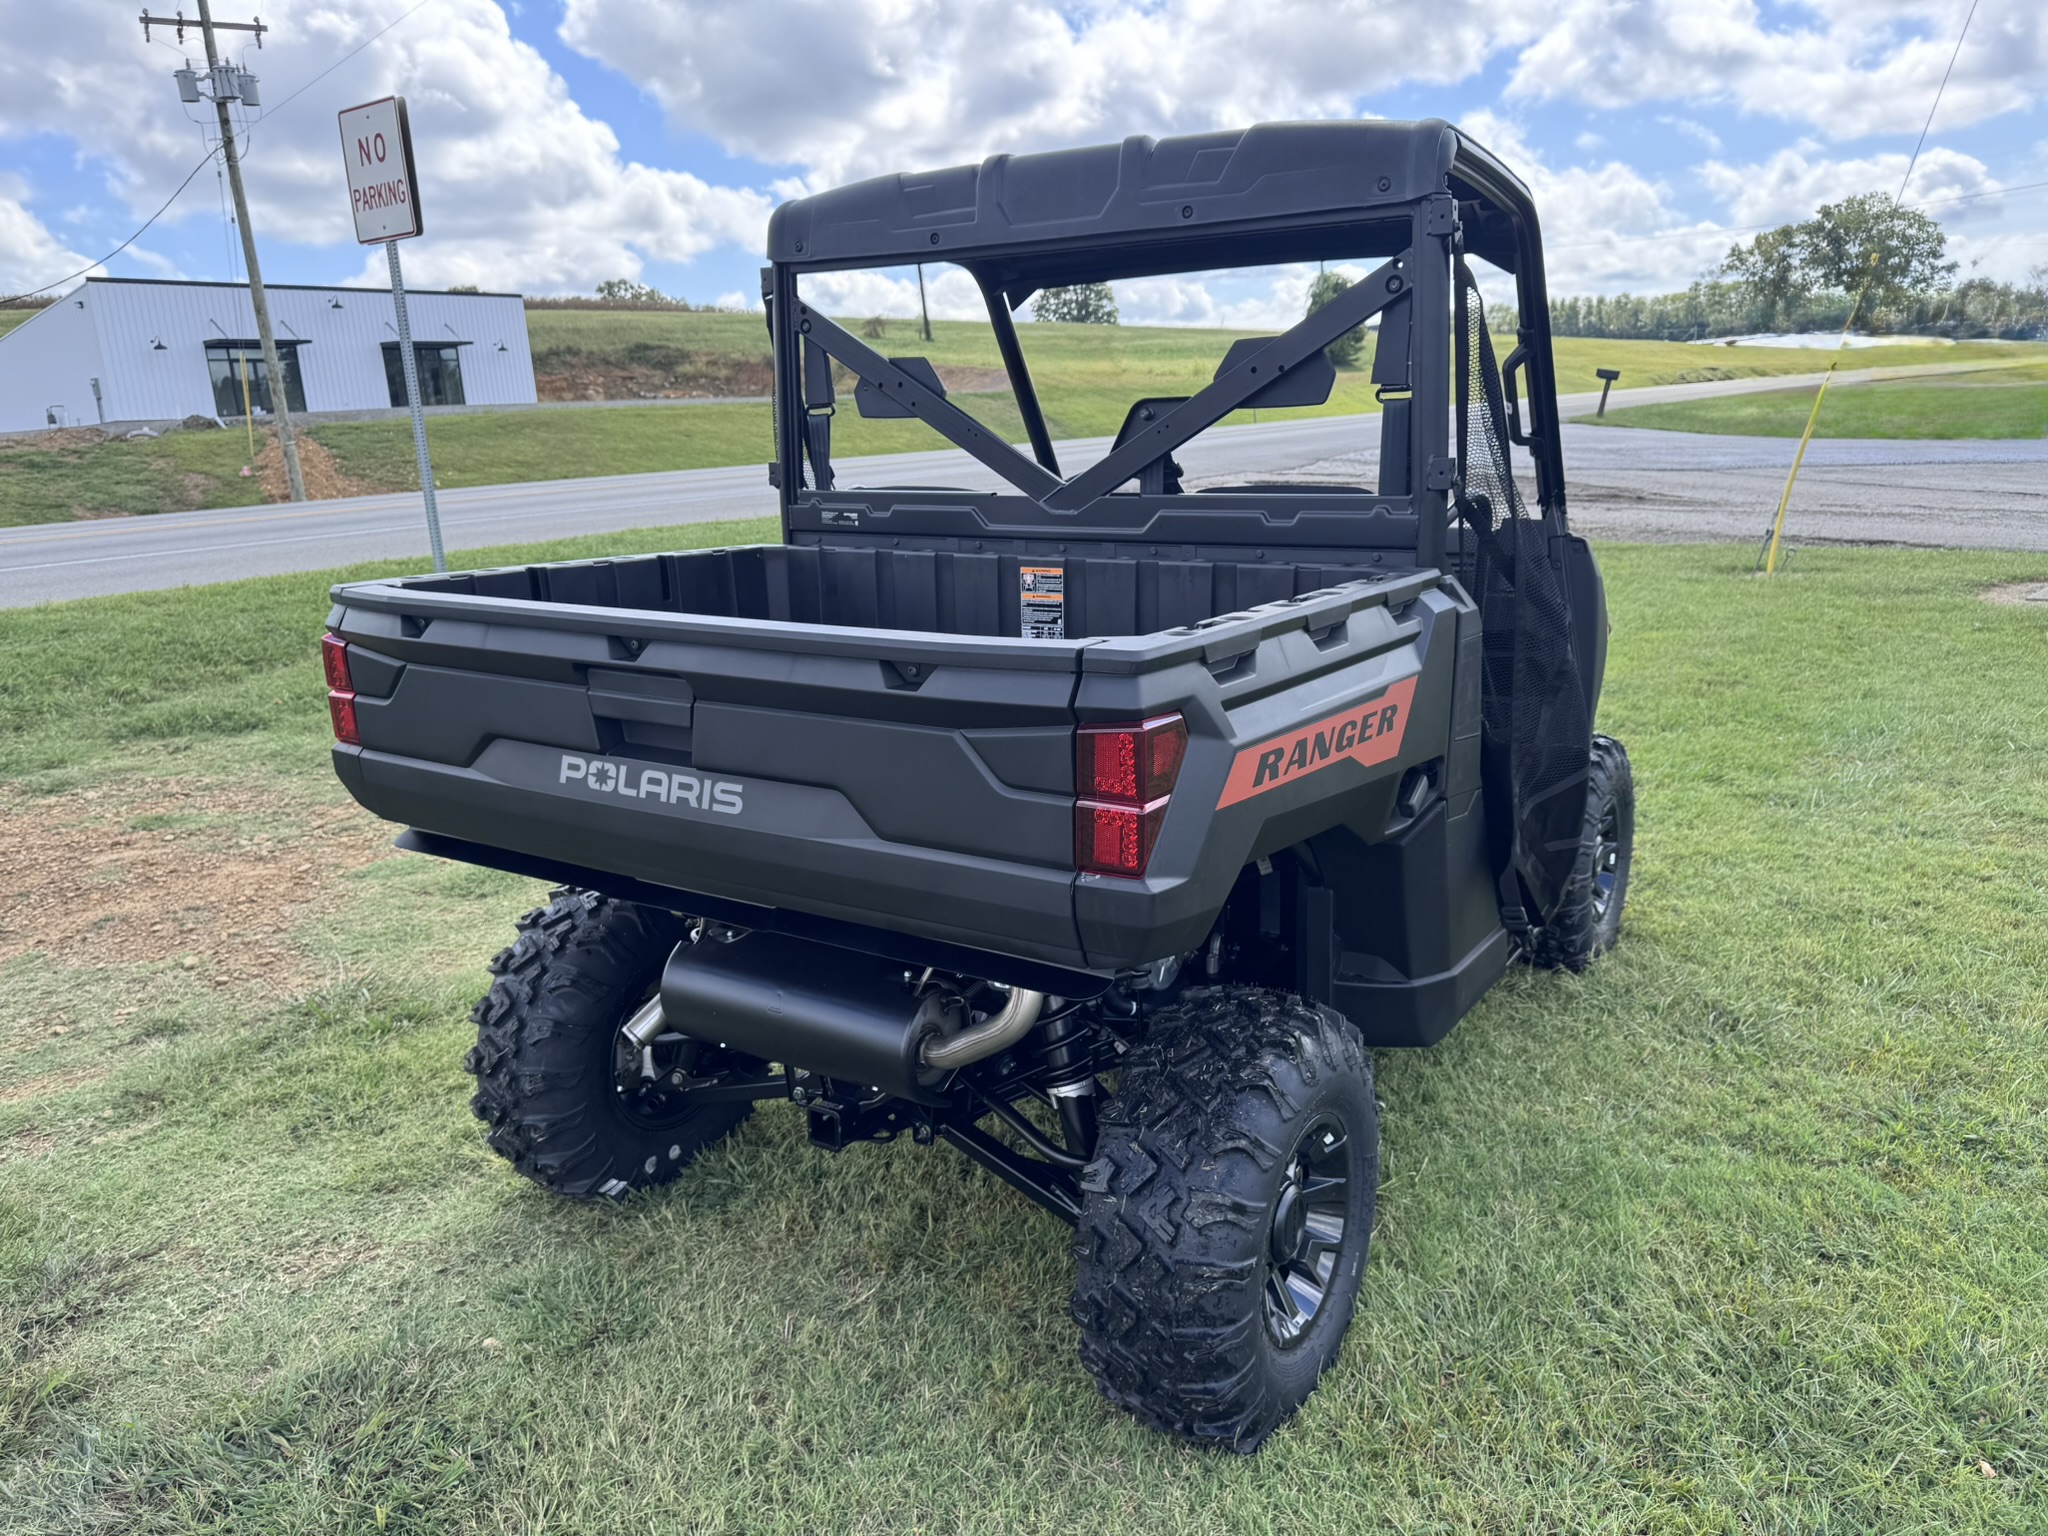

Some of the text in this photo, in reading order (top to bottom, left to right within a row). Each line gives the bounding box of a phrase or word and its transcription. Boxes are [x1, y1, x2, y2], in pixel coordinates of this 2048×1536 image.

[357, 132, 386, 167] NO
[353, 178, 406, 213] PARKING
[1252, 703, 1398, 788] RANGER
[559, 754, 743, 815] POLARIS
